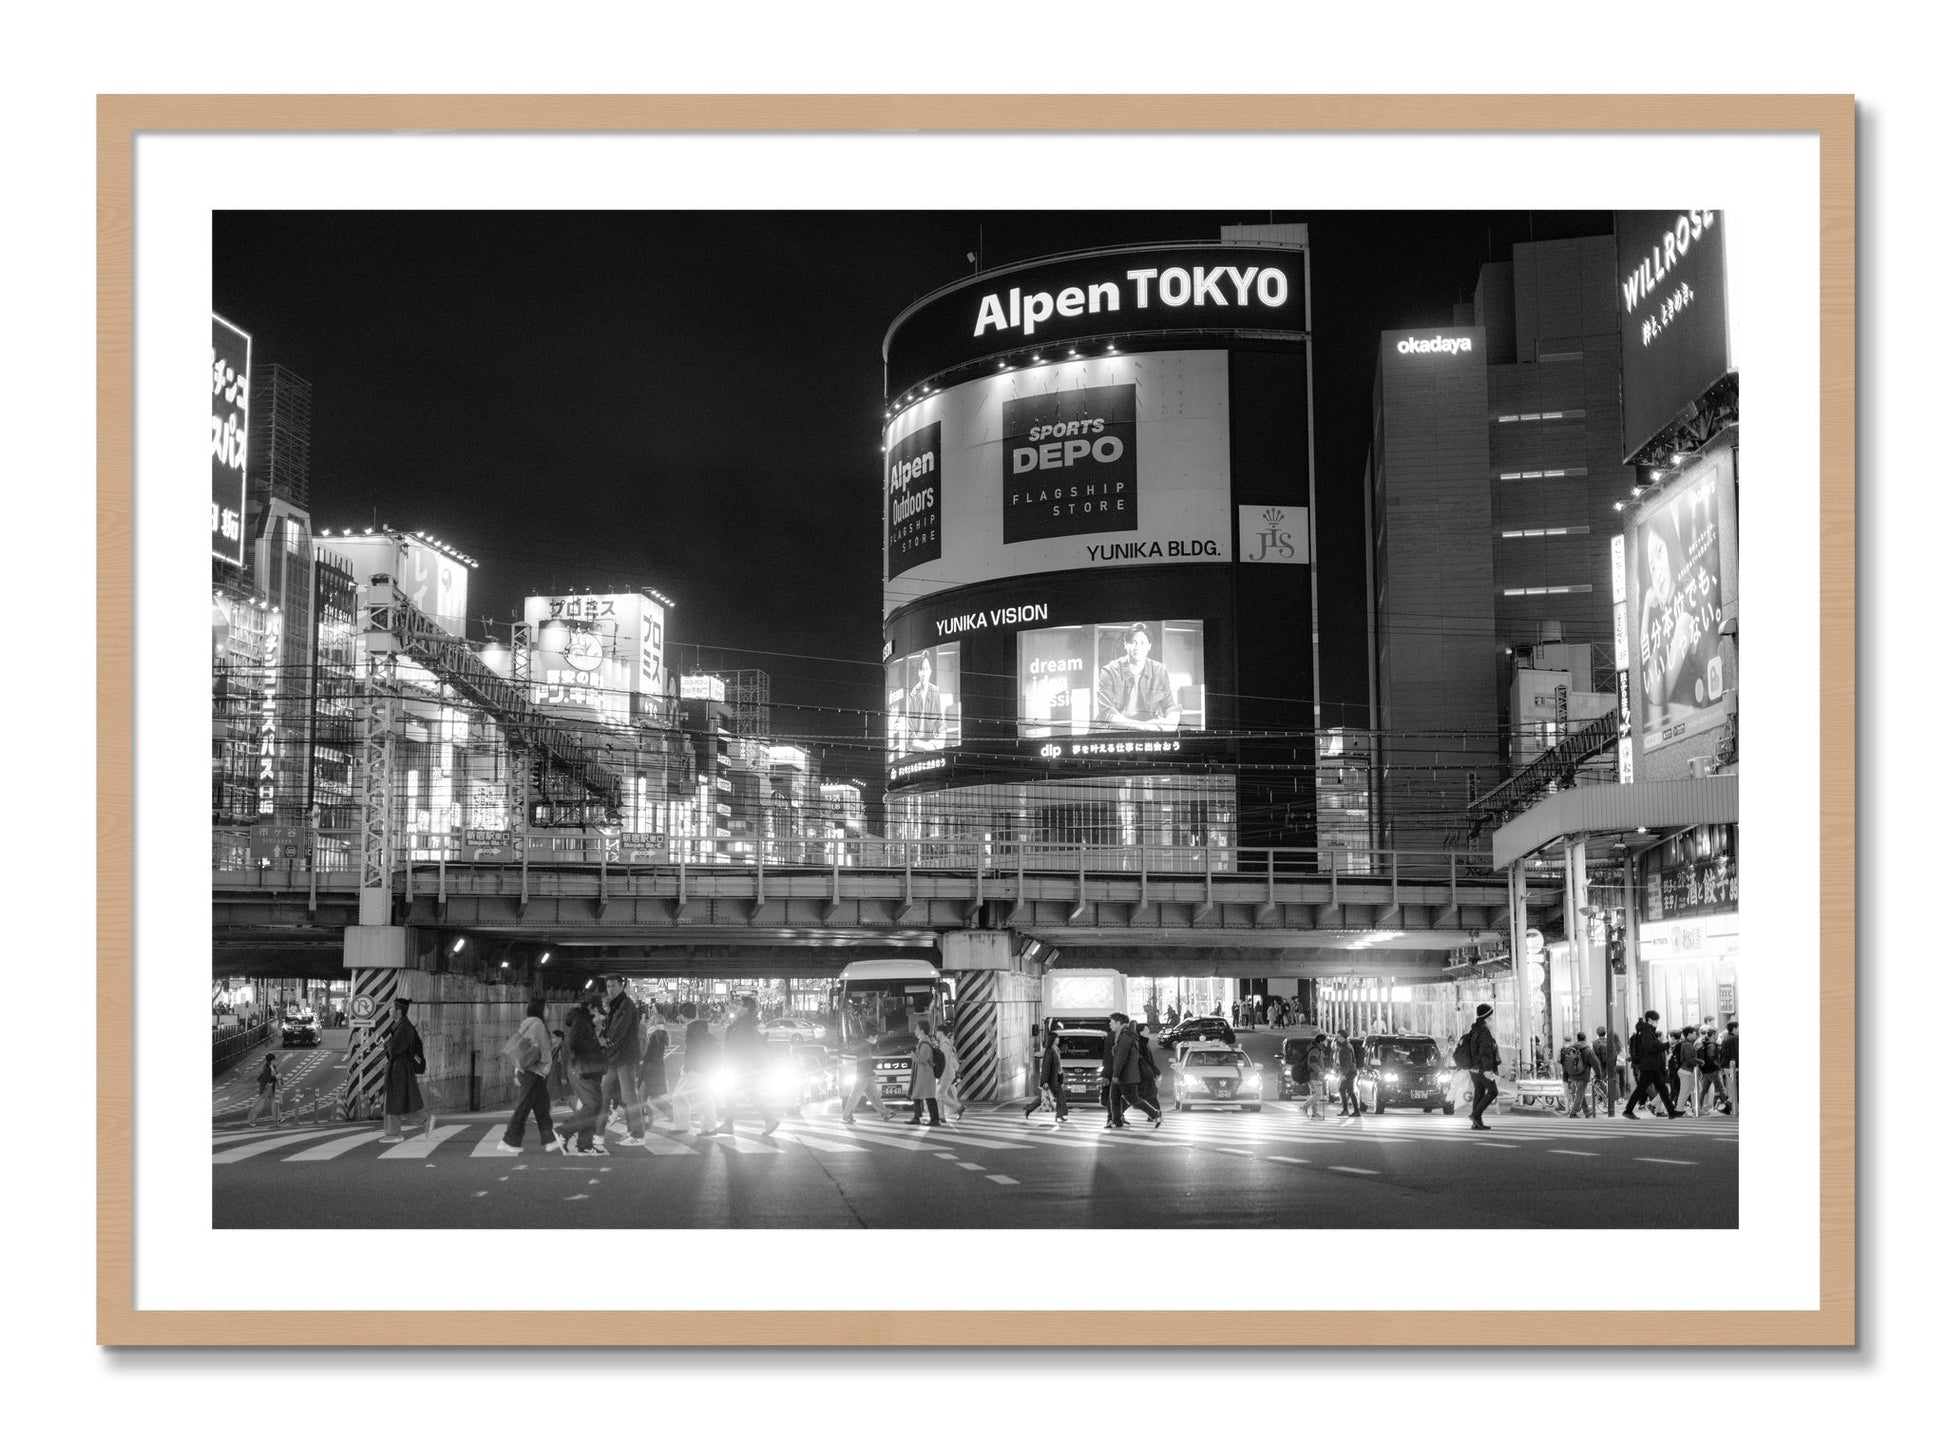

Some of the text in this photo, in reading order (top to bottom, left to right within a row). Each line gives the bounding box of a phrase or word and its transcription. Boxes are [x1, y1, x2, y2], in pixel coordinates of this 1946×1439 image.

[974, 267, 1287, 337] Alpen TOKYO
[1397, 335, 1472, 356] okadaya
[212, 347, 247, 410] チンコ
[1029, 418, 1105, 441] SPORTS
[1013, 436, 1124, 474] DEPO
[890, 451, 934, 495] Alpen
[1013, 482, 1124, 505] FLAGSHIP
[893, 487, 934, 526] Outdoors
[1053, 500, 1124, 516] STORE
[890, 515, 935, 546] FLAGSHIP
[902, 531, 935, 552] STORE
[1087, 540, 1221, 561] YUNIKA BLDG.
[324, 603, 353, 624] SHISHA
[549, 598, 617, 619] プロミス
[936, 603, 1048, 636] YUNIKA VISION
[1030, 658, 1083, 674] dream
[1041, 741, 1181, 758] dip 夢を叶える仕事に出会おう
